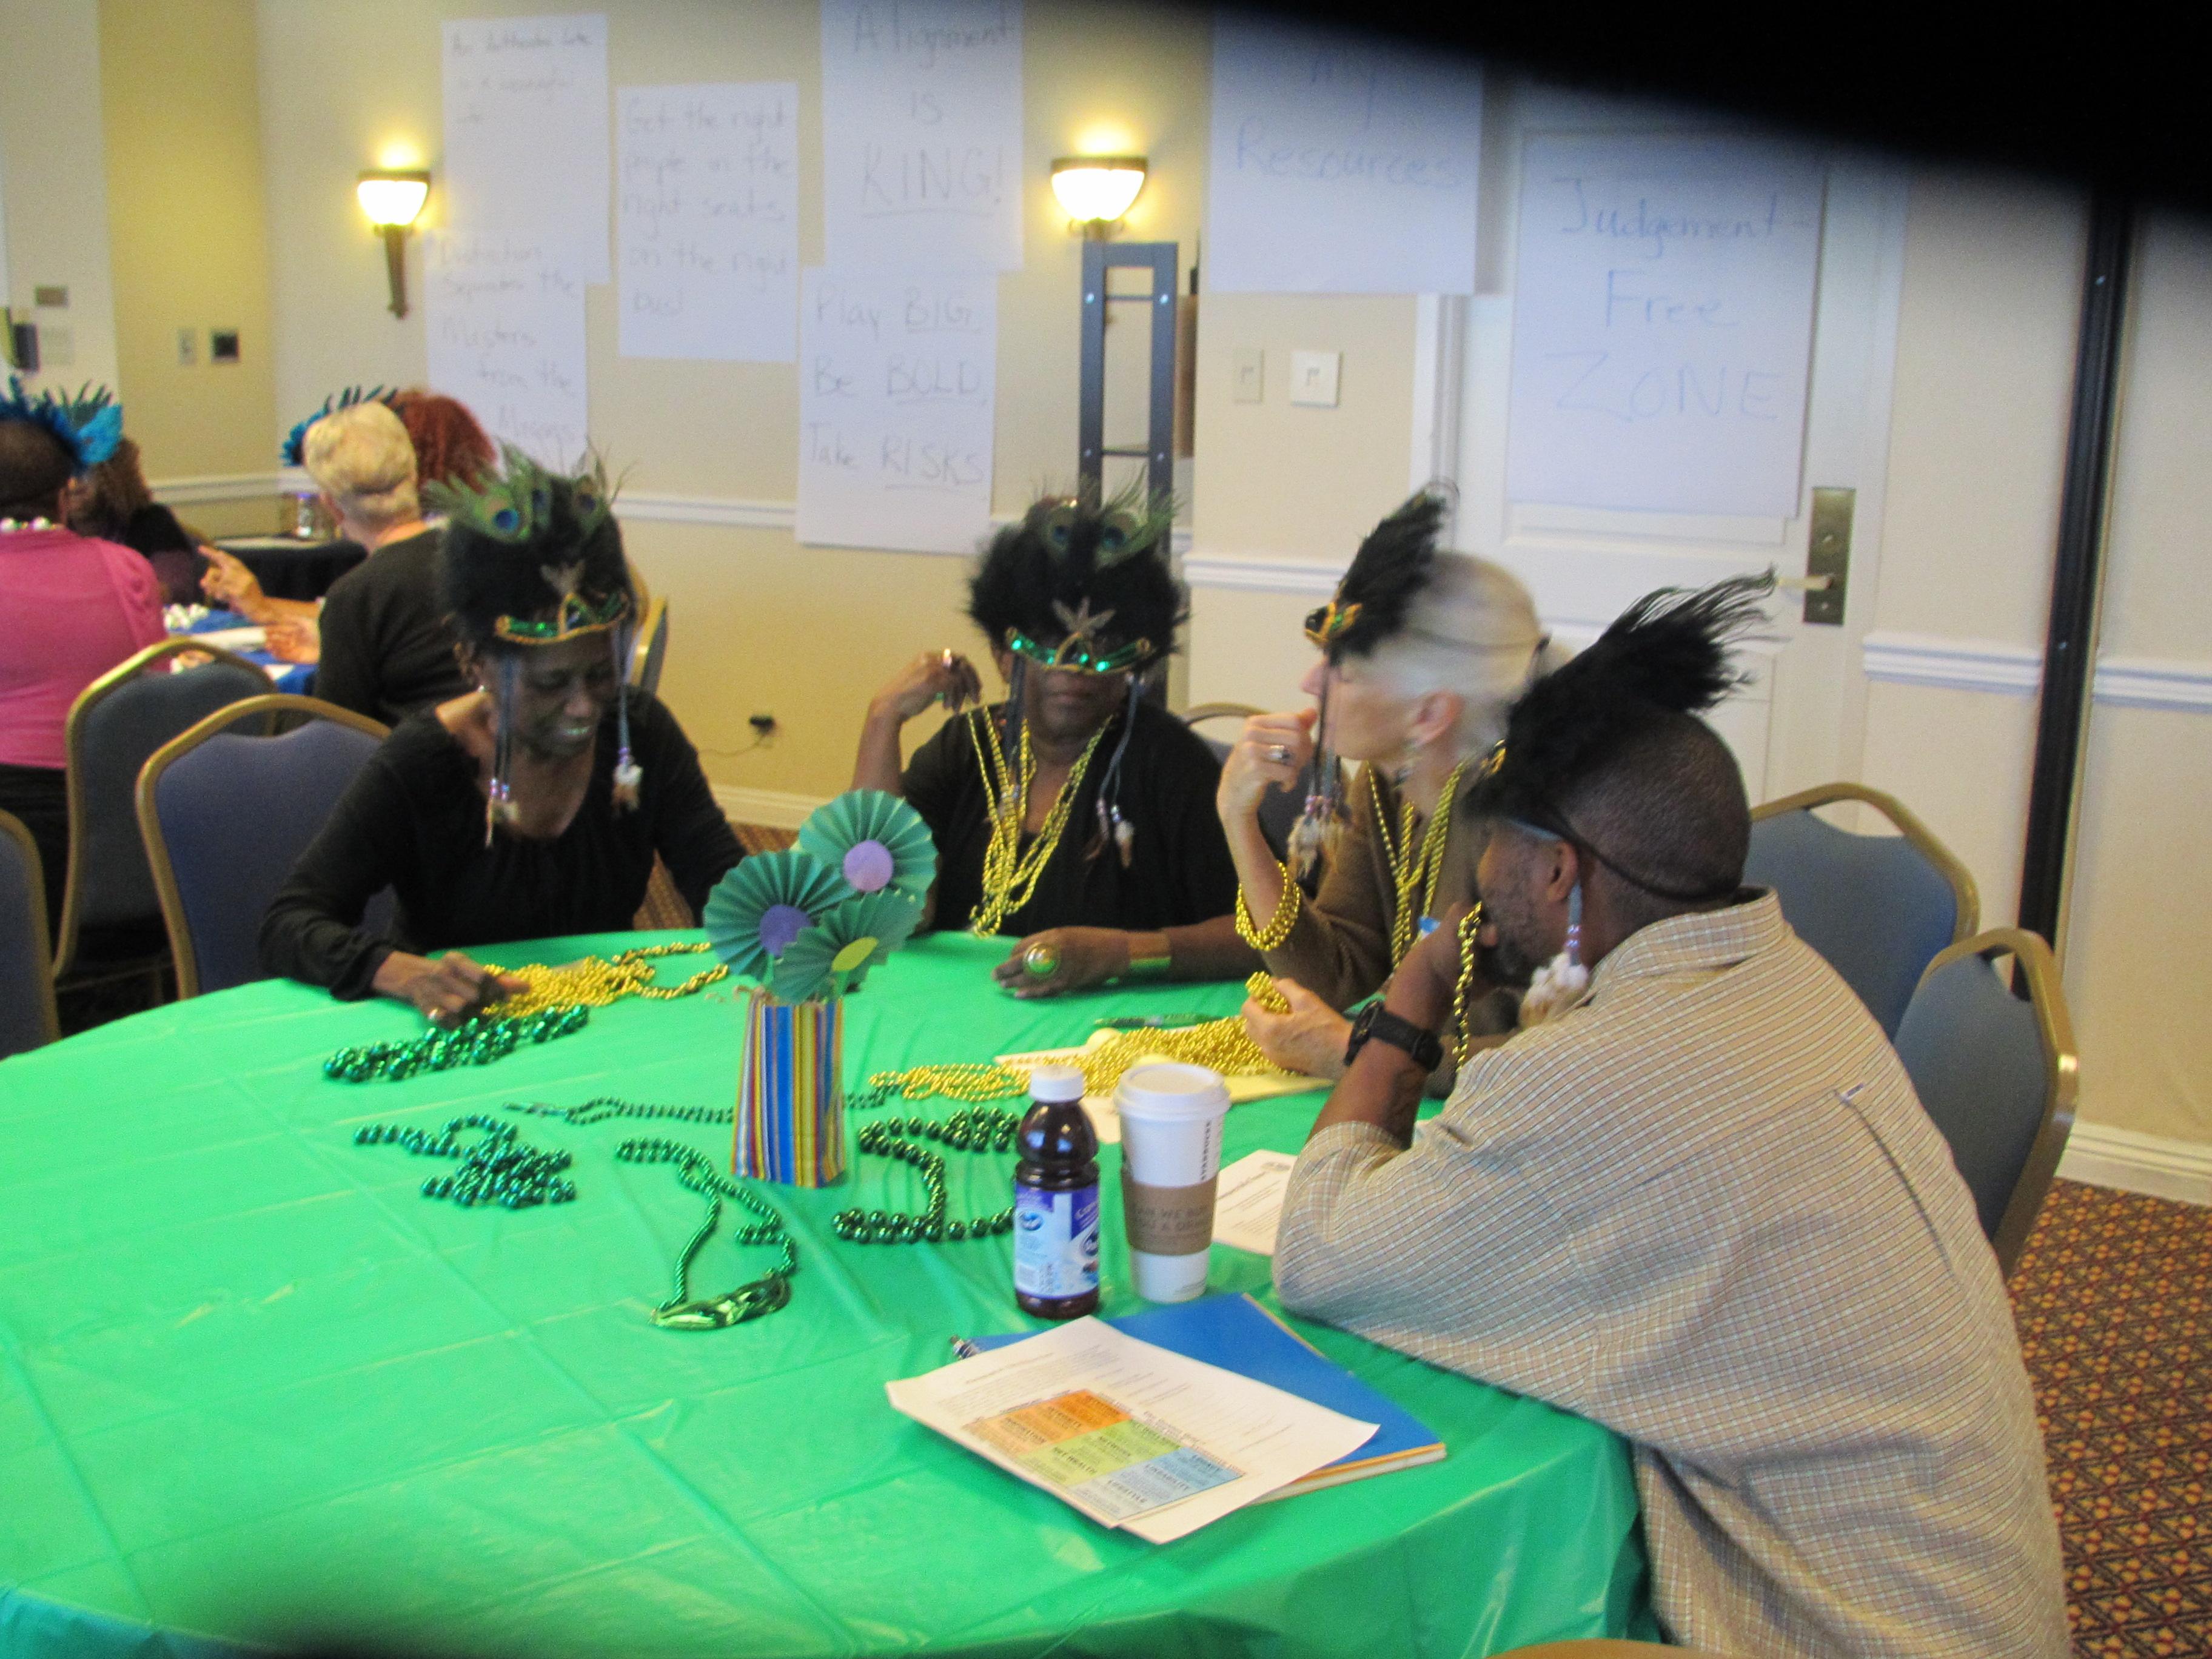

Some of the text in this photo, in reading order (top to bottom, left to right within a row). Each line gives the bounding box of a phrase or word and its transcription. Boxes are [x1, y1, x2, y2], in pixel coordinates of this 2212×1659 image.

[860, 141, 1004, 206] KING!
[1236, 113, 1463, 189] Resources
[816, 281, 882, 343] Play
[1604, 267, 1740, 329] Free
[814, 352, 859, 398] Be
[1544, 349, 1785, 424] ZONE
